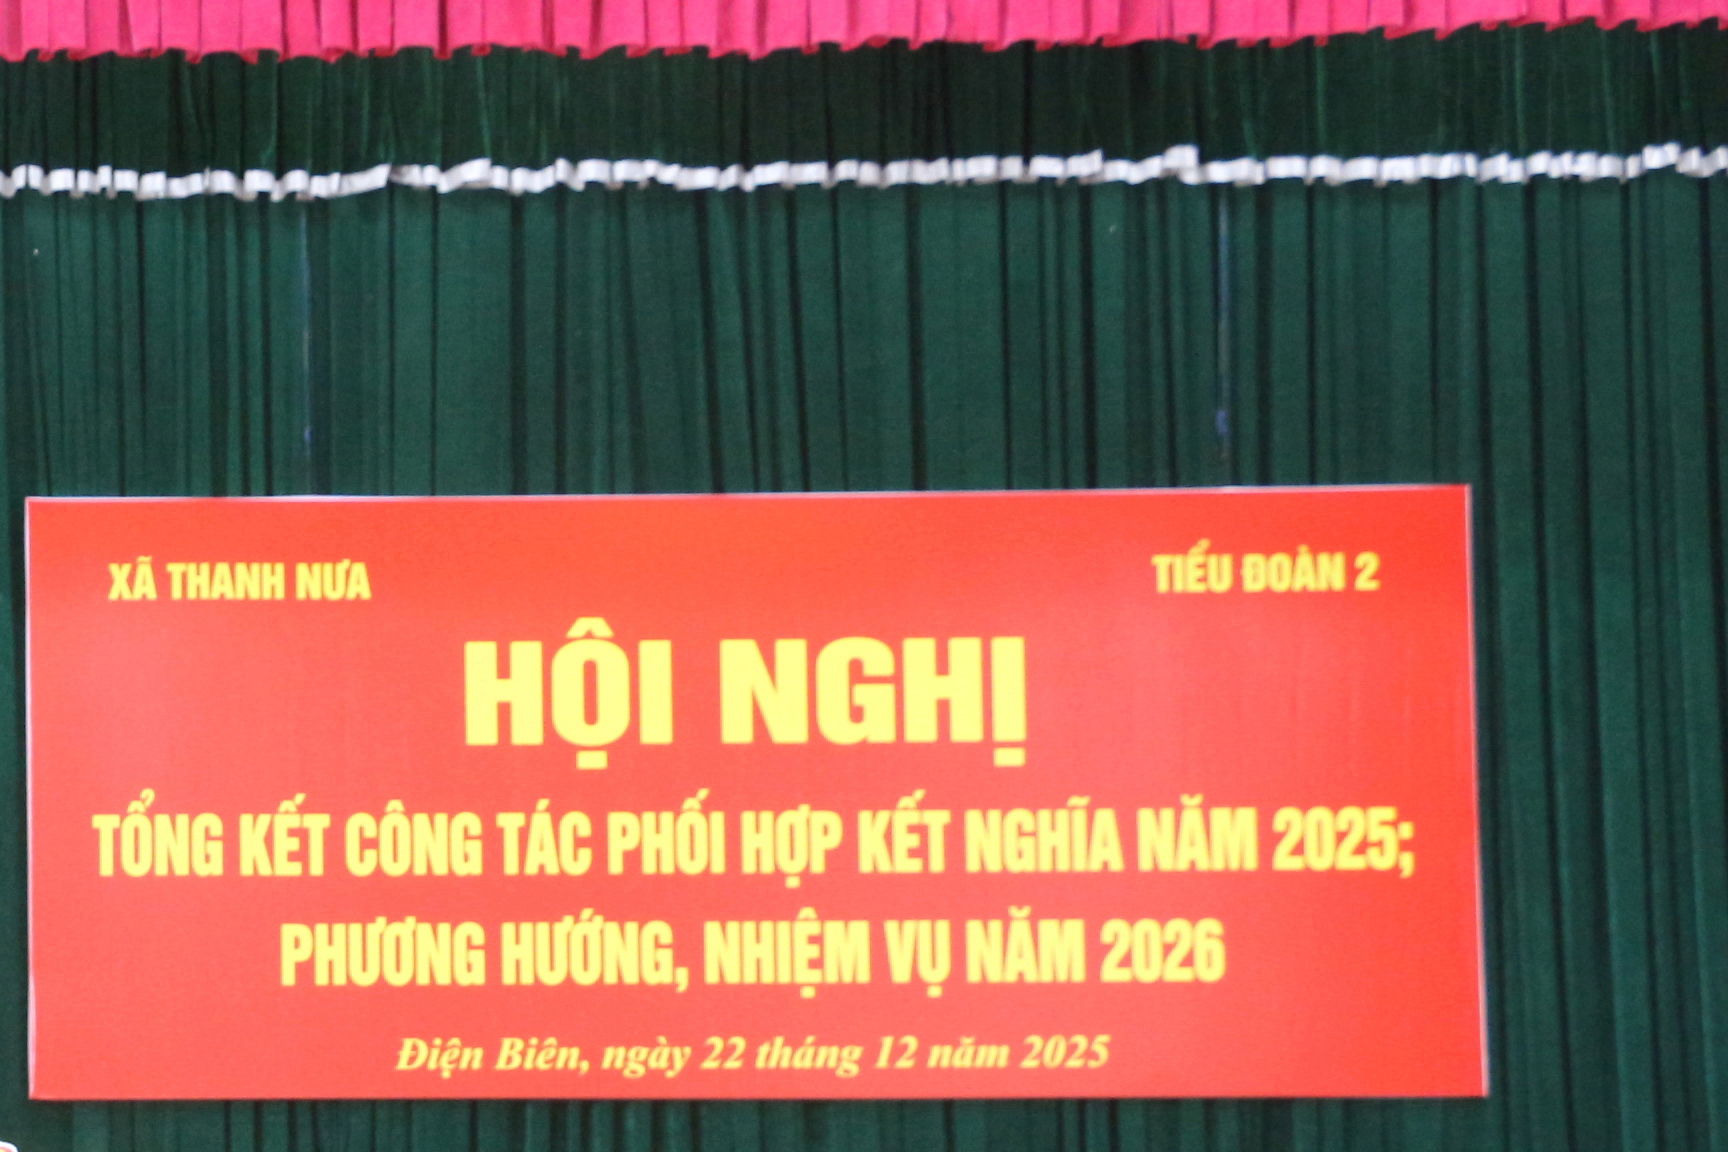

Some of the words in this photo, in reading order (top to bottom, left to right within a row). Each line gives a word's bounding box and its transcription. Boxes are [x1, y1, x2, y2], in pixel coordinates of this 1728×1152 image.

[108, 556, 157, 601] XÃ
[166, 562, 285, 600] THANH
[296, 559, 371, 600] NƯA
[1152, 540, 1233, 593] TIỂU
[1241, 546, 1345, 592] ĐOÀN
[1355, 552, 1379, 590] 2
[464, 617, 673, 770] HỘI
[720, 636, 1027, 767] NGHỊ
[92, 788, 223, 877] TỔNG
[239, 793, 330, 876] KẾT
[345, 800, 482, 877] CÔNG
[496, 799, 592, 876] TÁC
[608, 788, 725, 875] PHỐI
[741, 804, 843, 888] HỢP
[858, 789, 951, 873] KẾT
[965, 796, 1124, 873] NGHĨA
[1137, 794, 1258, 872] NĂM
[1273, 806, 1414, 877] 2025;
[280, 916, 485, 986] PHƯƠNG
[501, 908, 689, 992] HƯỚNG,
[704, 907, 871, 998] NHIỆM
[884, 920, 951, 998] VỤ
[966, 906, 1086, 983] NĂM
[1100, 918, 1226, 983] 2026
[396, 1038, 483, 1078] Điện
[495, 1037, 589, 1073] Biên,
[602, 1036, 691, 1077] ngày
[701, 1036, 746, 1069] 22
[756, 1036, 863, 1077] tháng
[876, 1035, 918, 1068] 12
[928, 1037, 1010, 1068] năm
[1021, 1035, 1110, 1068] 2025
